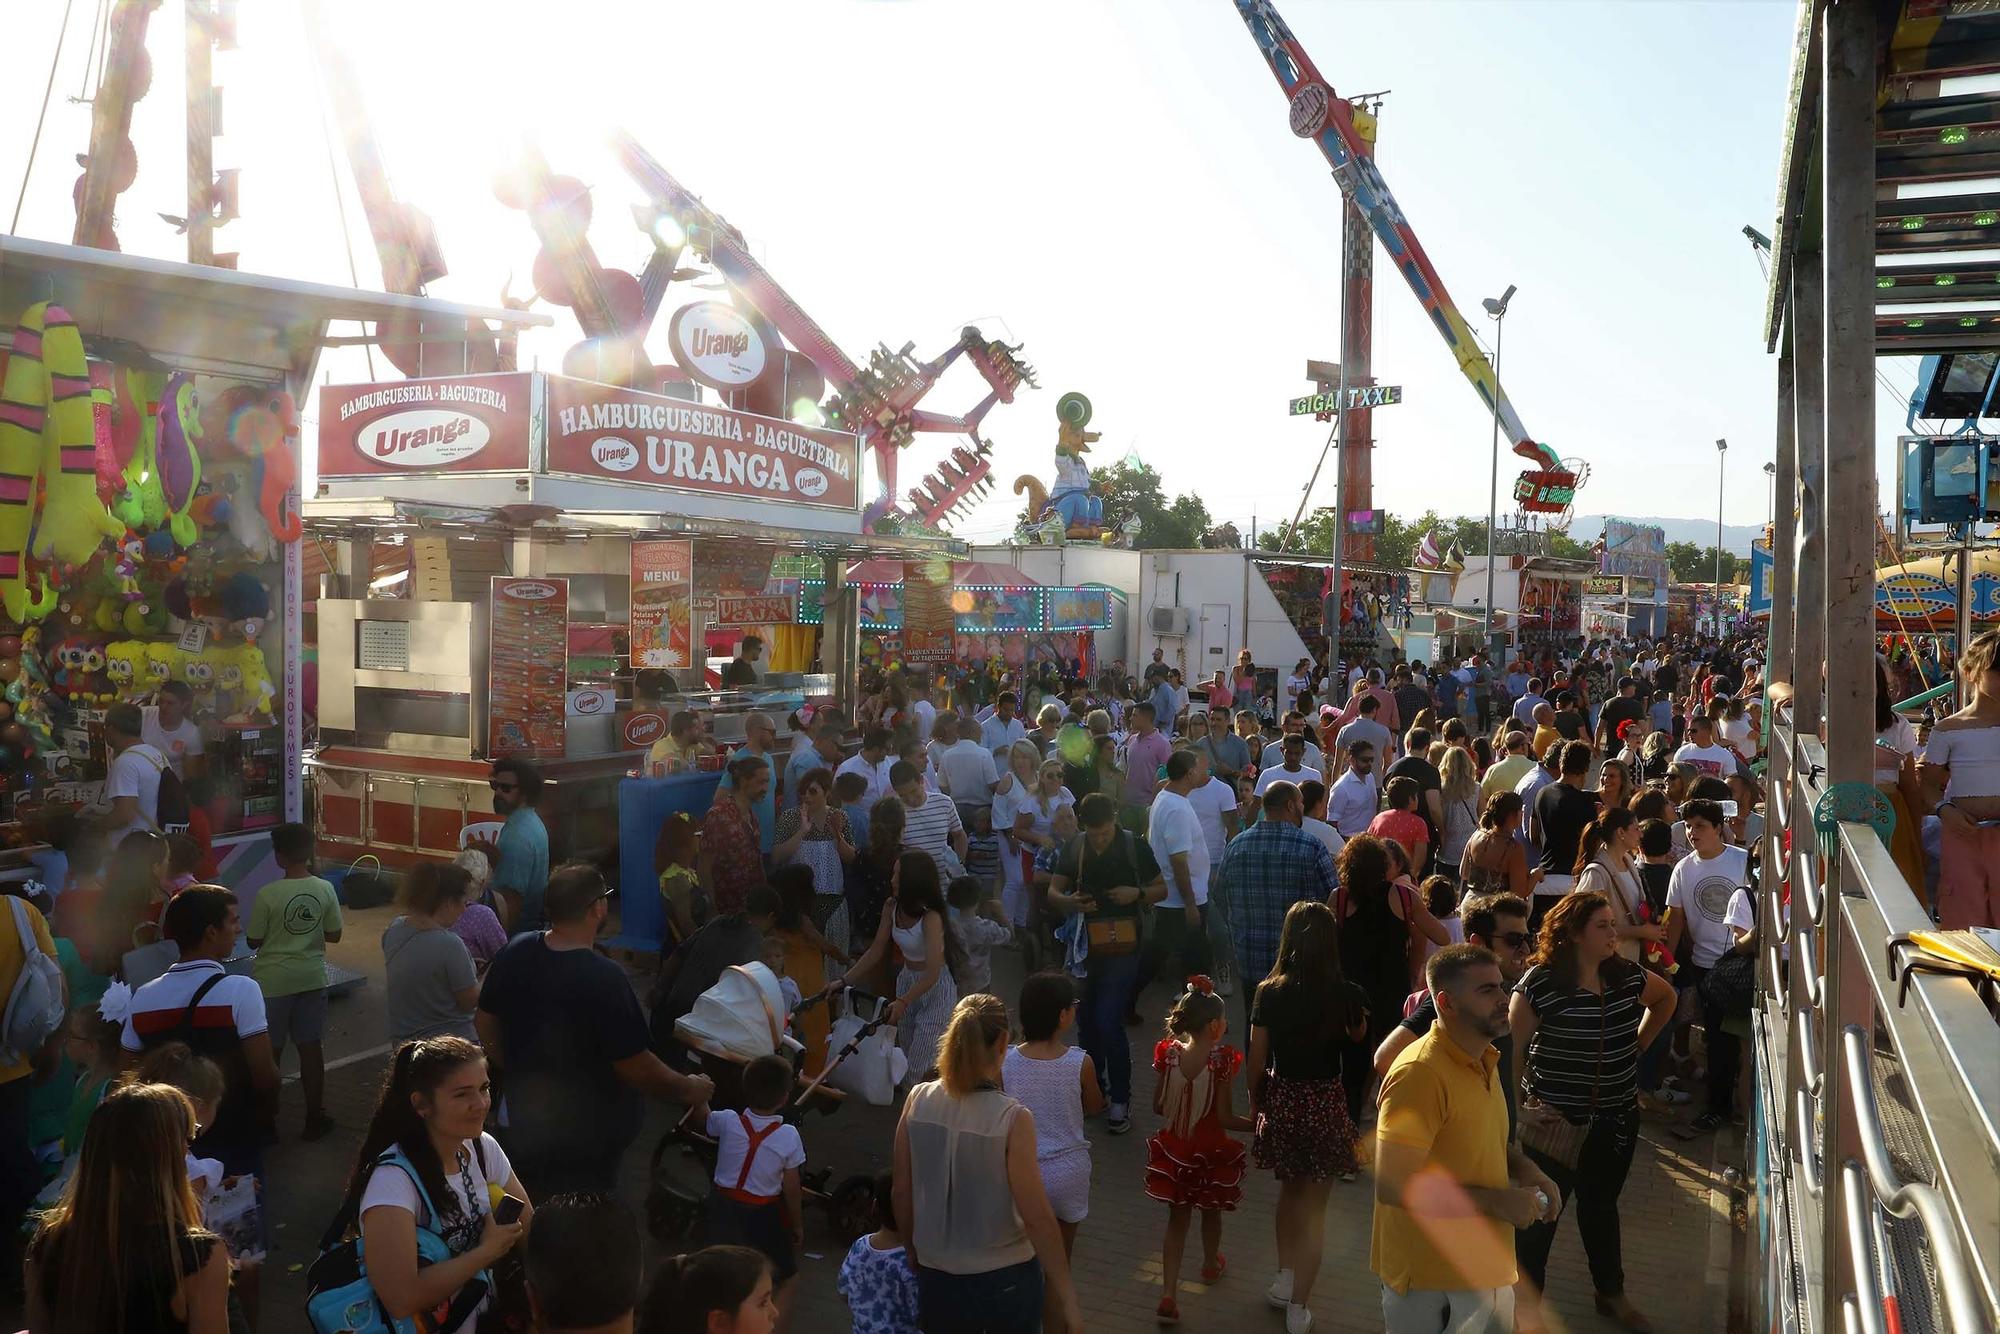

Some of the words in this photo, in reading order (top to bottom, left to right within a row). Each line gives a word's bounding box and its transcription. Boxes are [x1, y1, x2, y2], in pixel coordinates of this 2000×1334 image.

[692, 328, 748, 358] Uranga
[340, 384, 433, 421] HAMBURGUESERIA
[440, 384, 507, 413] BAGUETERIA
[375, 418, 470, 457] Uranga
[559, 403, 743, 442] HAMBURGUESERIA
[754, 423, 850, 480] BAGUETERIA
[597, 446, 630, 462] Uranga
[646, 436, 791, 491] URANGA
[799, 475, 821, 489] Uranga
[643, 571, 680, 582] MENU
[720, 597, 790, 619] URANGA
[732, 609, 777, 622] CAJA
[578, 695, 598, 709] Uranga
[286, 660, 296, 779] EUROGAMES
[632, 720, 658, 739] Uranga
